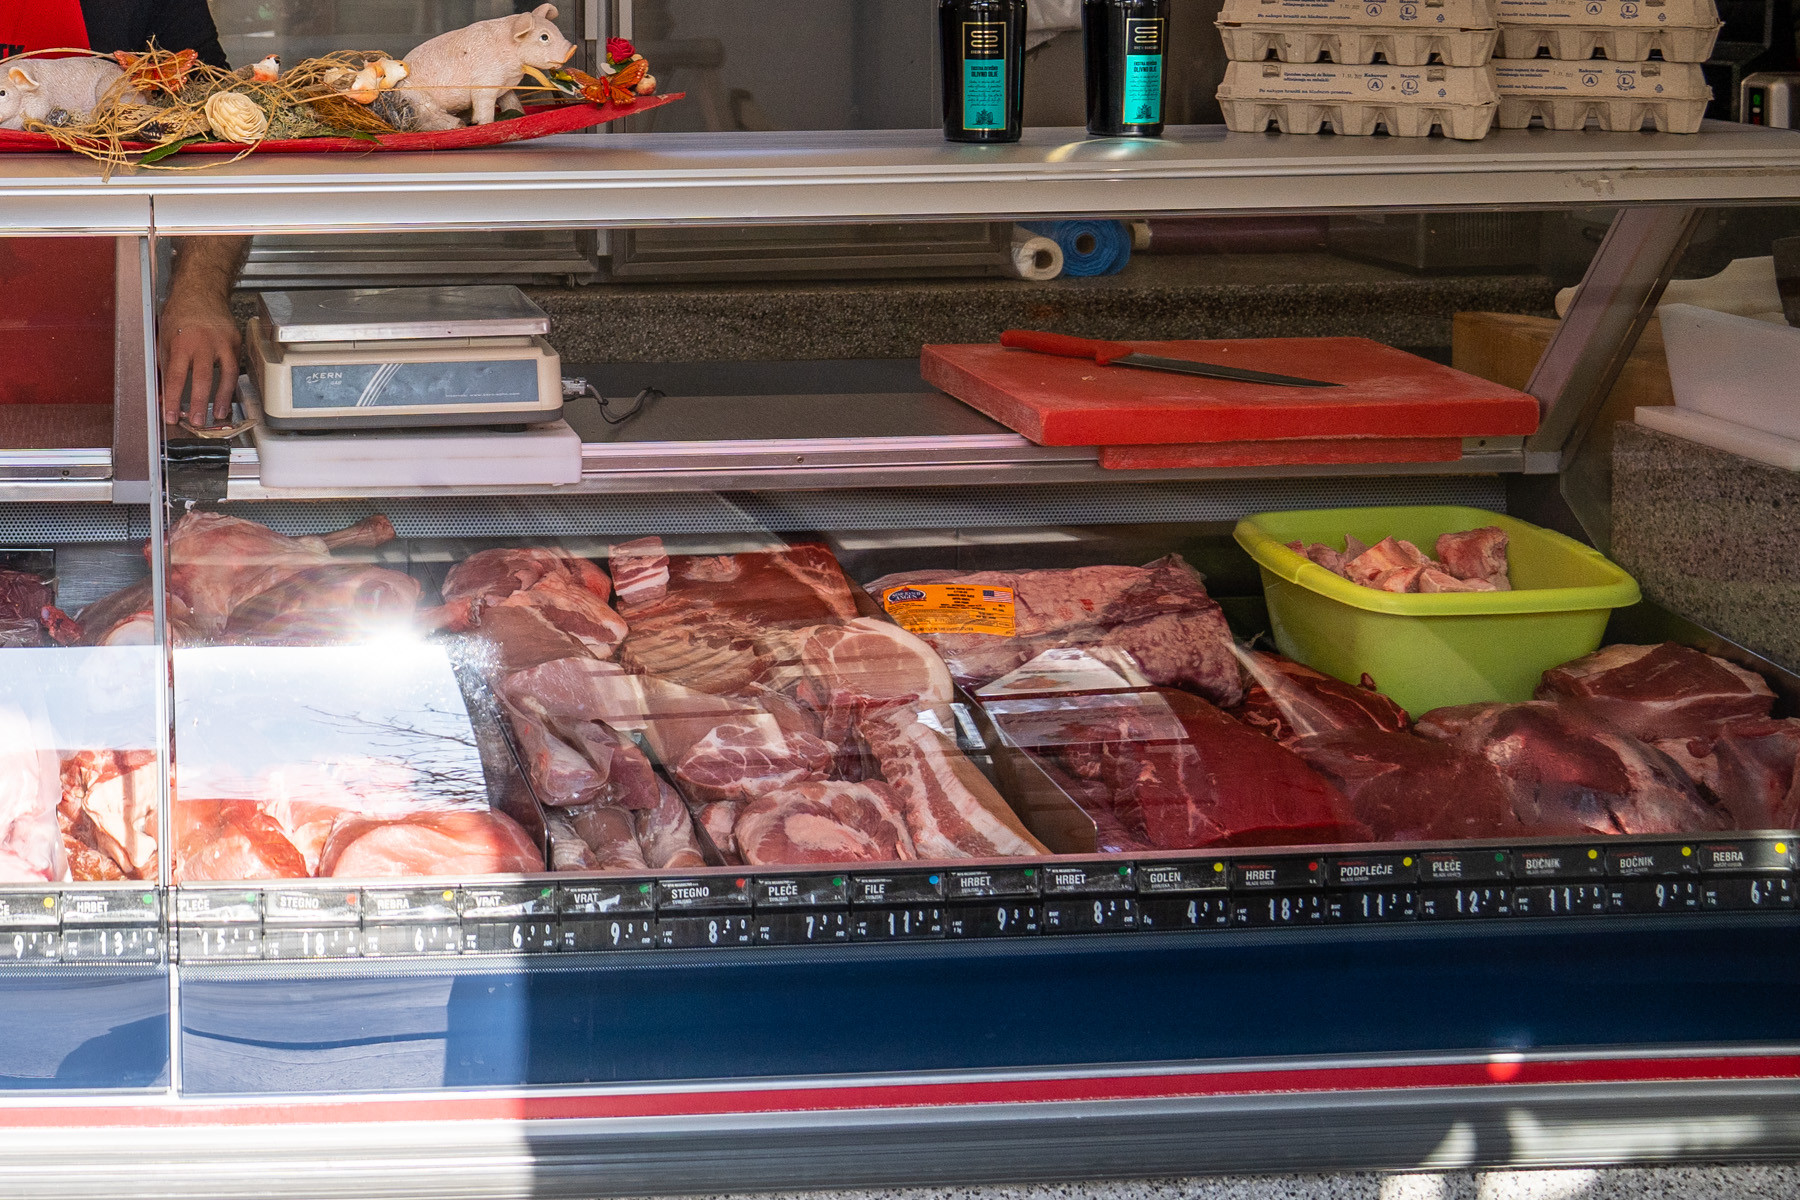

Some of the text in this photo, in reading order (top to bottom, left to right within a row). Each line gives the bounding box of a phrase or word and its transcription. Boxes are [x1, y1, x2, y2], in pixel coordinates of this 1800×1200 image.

[311, 371, 342, 380] KERN
[1619, 853, 1654, 869] BOČNIK
[1712, 850, 1744, 863] REBRA
[1245, 868, 1276, 882] HRBET
[1339, 860, 1394, 878] PODPLEČJE
[1149, 870, 1181, 884] GOLEN
[671, 886, 710, 900] STEGNO
[767, 883, 798, 897] PLEČE
[864, 882, 885, 895] FILE
[573, 892, 599, 905] VRAT
